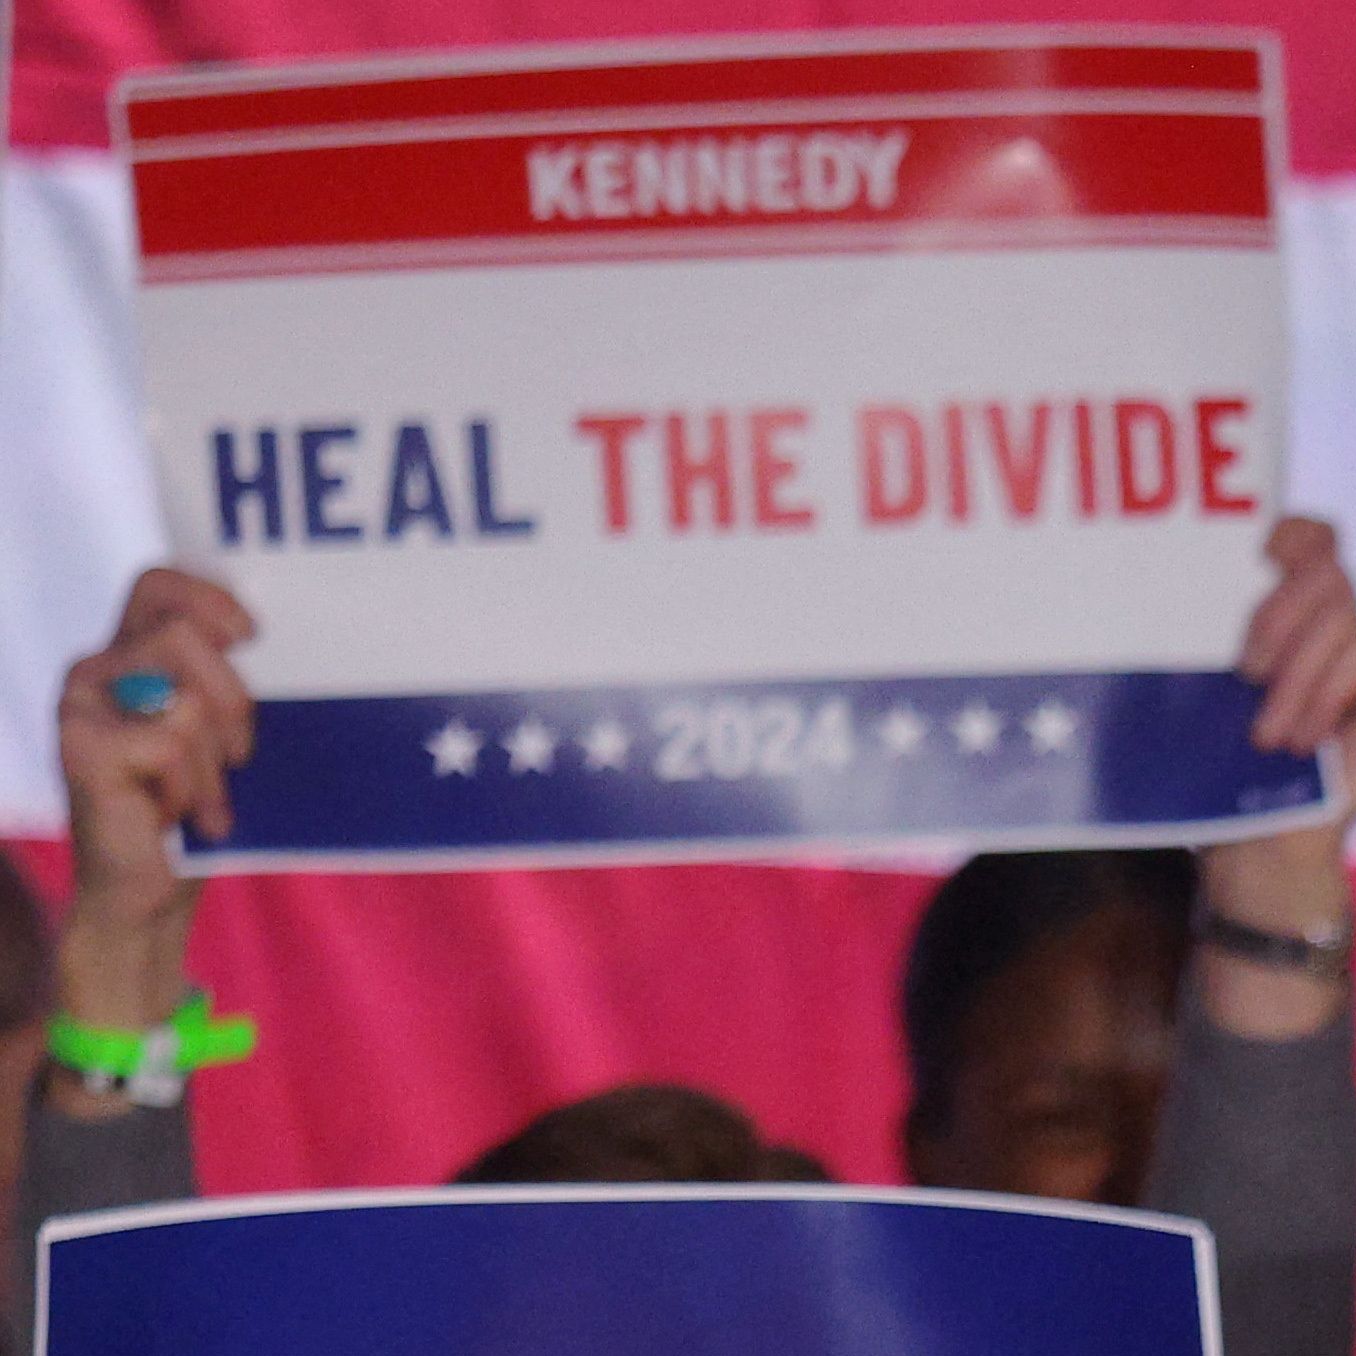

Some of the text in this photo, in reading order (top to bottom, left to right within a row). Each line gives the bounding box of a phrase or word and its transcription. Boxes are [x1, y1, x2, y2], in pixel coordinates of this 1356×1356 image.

[526, 129, 910, 221] KENNEDY
[208, 393, 1262, 549] HEAL THE DIVIDE
[654, 698, 853, 782] 2024
